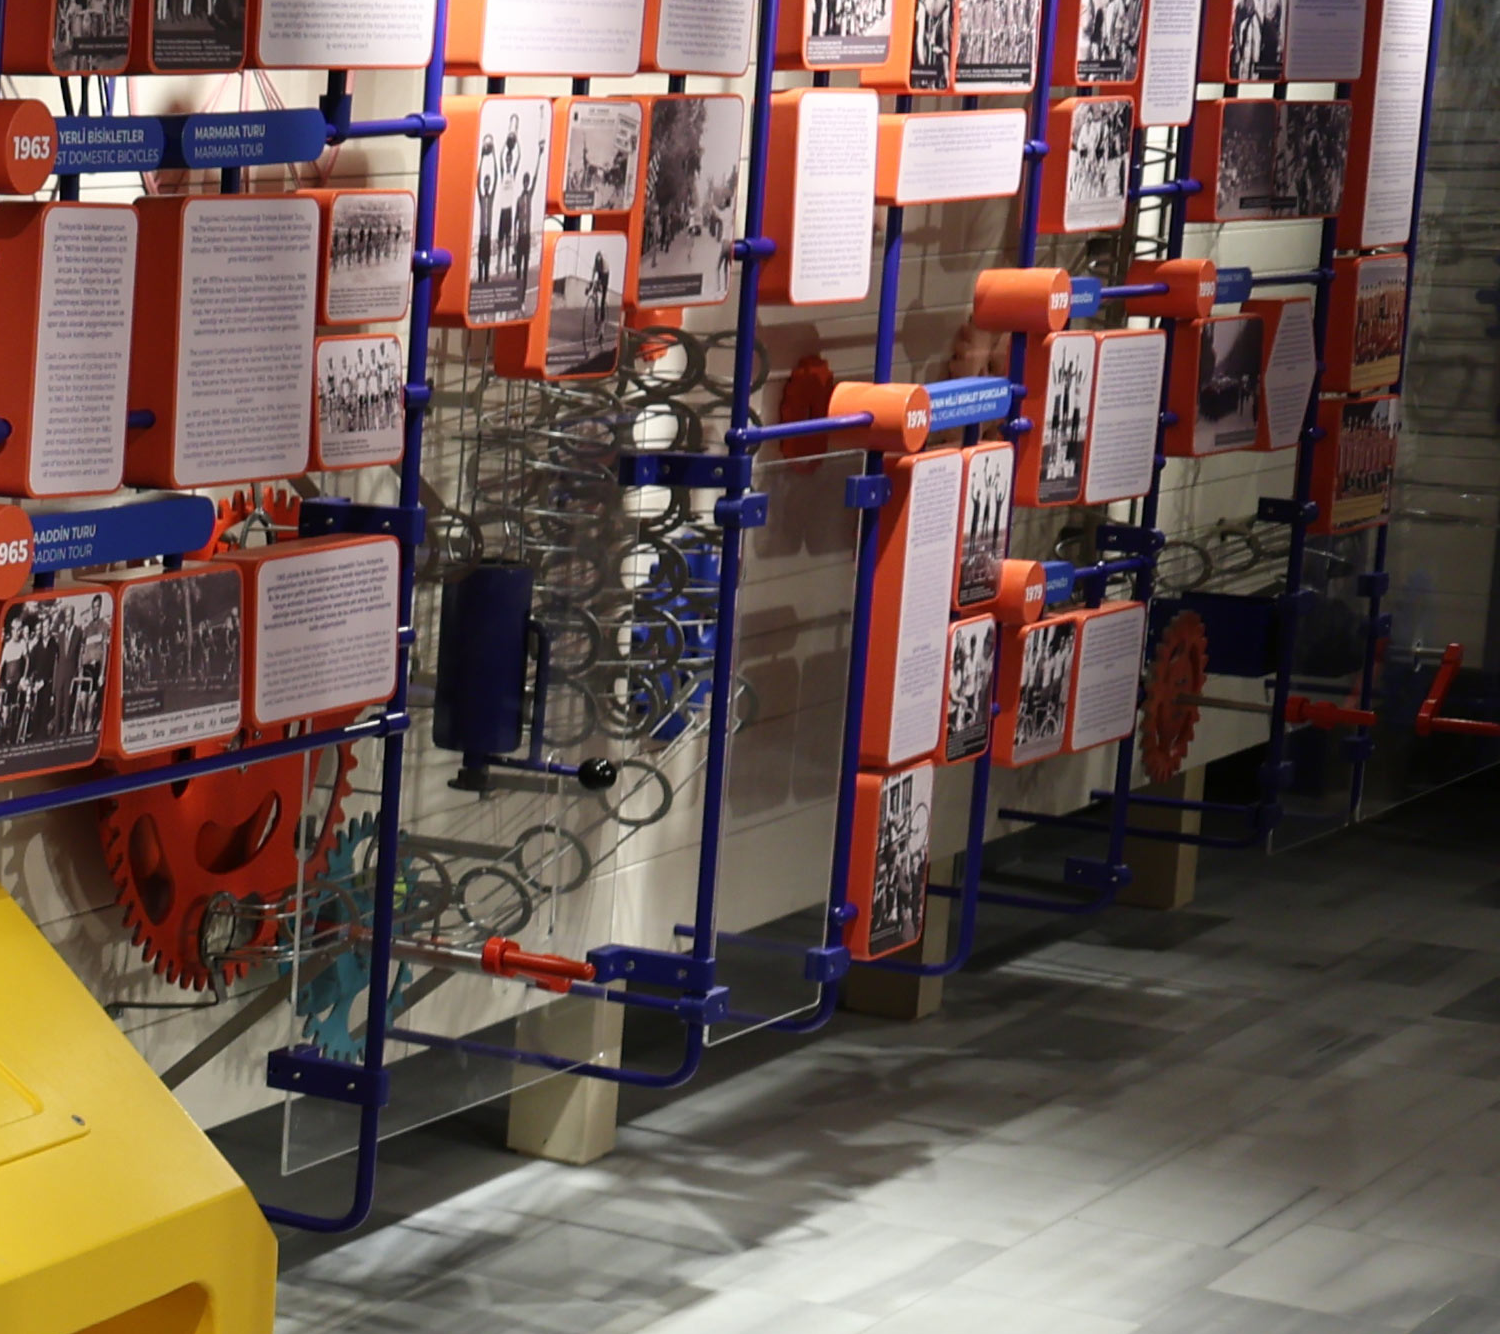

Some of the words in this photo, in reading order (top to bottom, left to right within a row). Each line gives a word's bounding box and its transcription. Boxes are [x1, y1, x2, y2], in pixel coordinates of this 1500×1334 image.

[59, 127, 86, 145] YERLİ
[88, 126, 144, 144] BİSİKLETLER
[195, 126, 240, 140] MARMARA
[241, 124, 266, 138] TURU
[13, 136, 50, 160] 1963
[69, 149, 116, 166] DOMESTIC
[117, 147, 160, 164] BICYCLES
[194, 144, 238, 160] MARMARA
[239, 143, 264, 158] TOUR
[33, 525, 70, 545] AADDİN
[72, 524, 97, 540] TURU
[69, 544, 93, 560] TOUR
